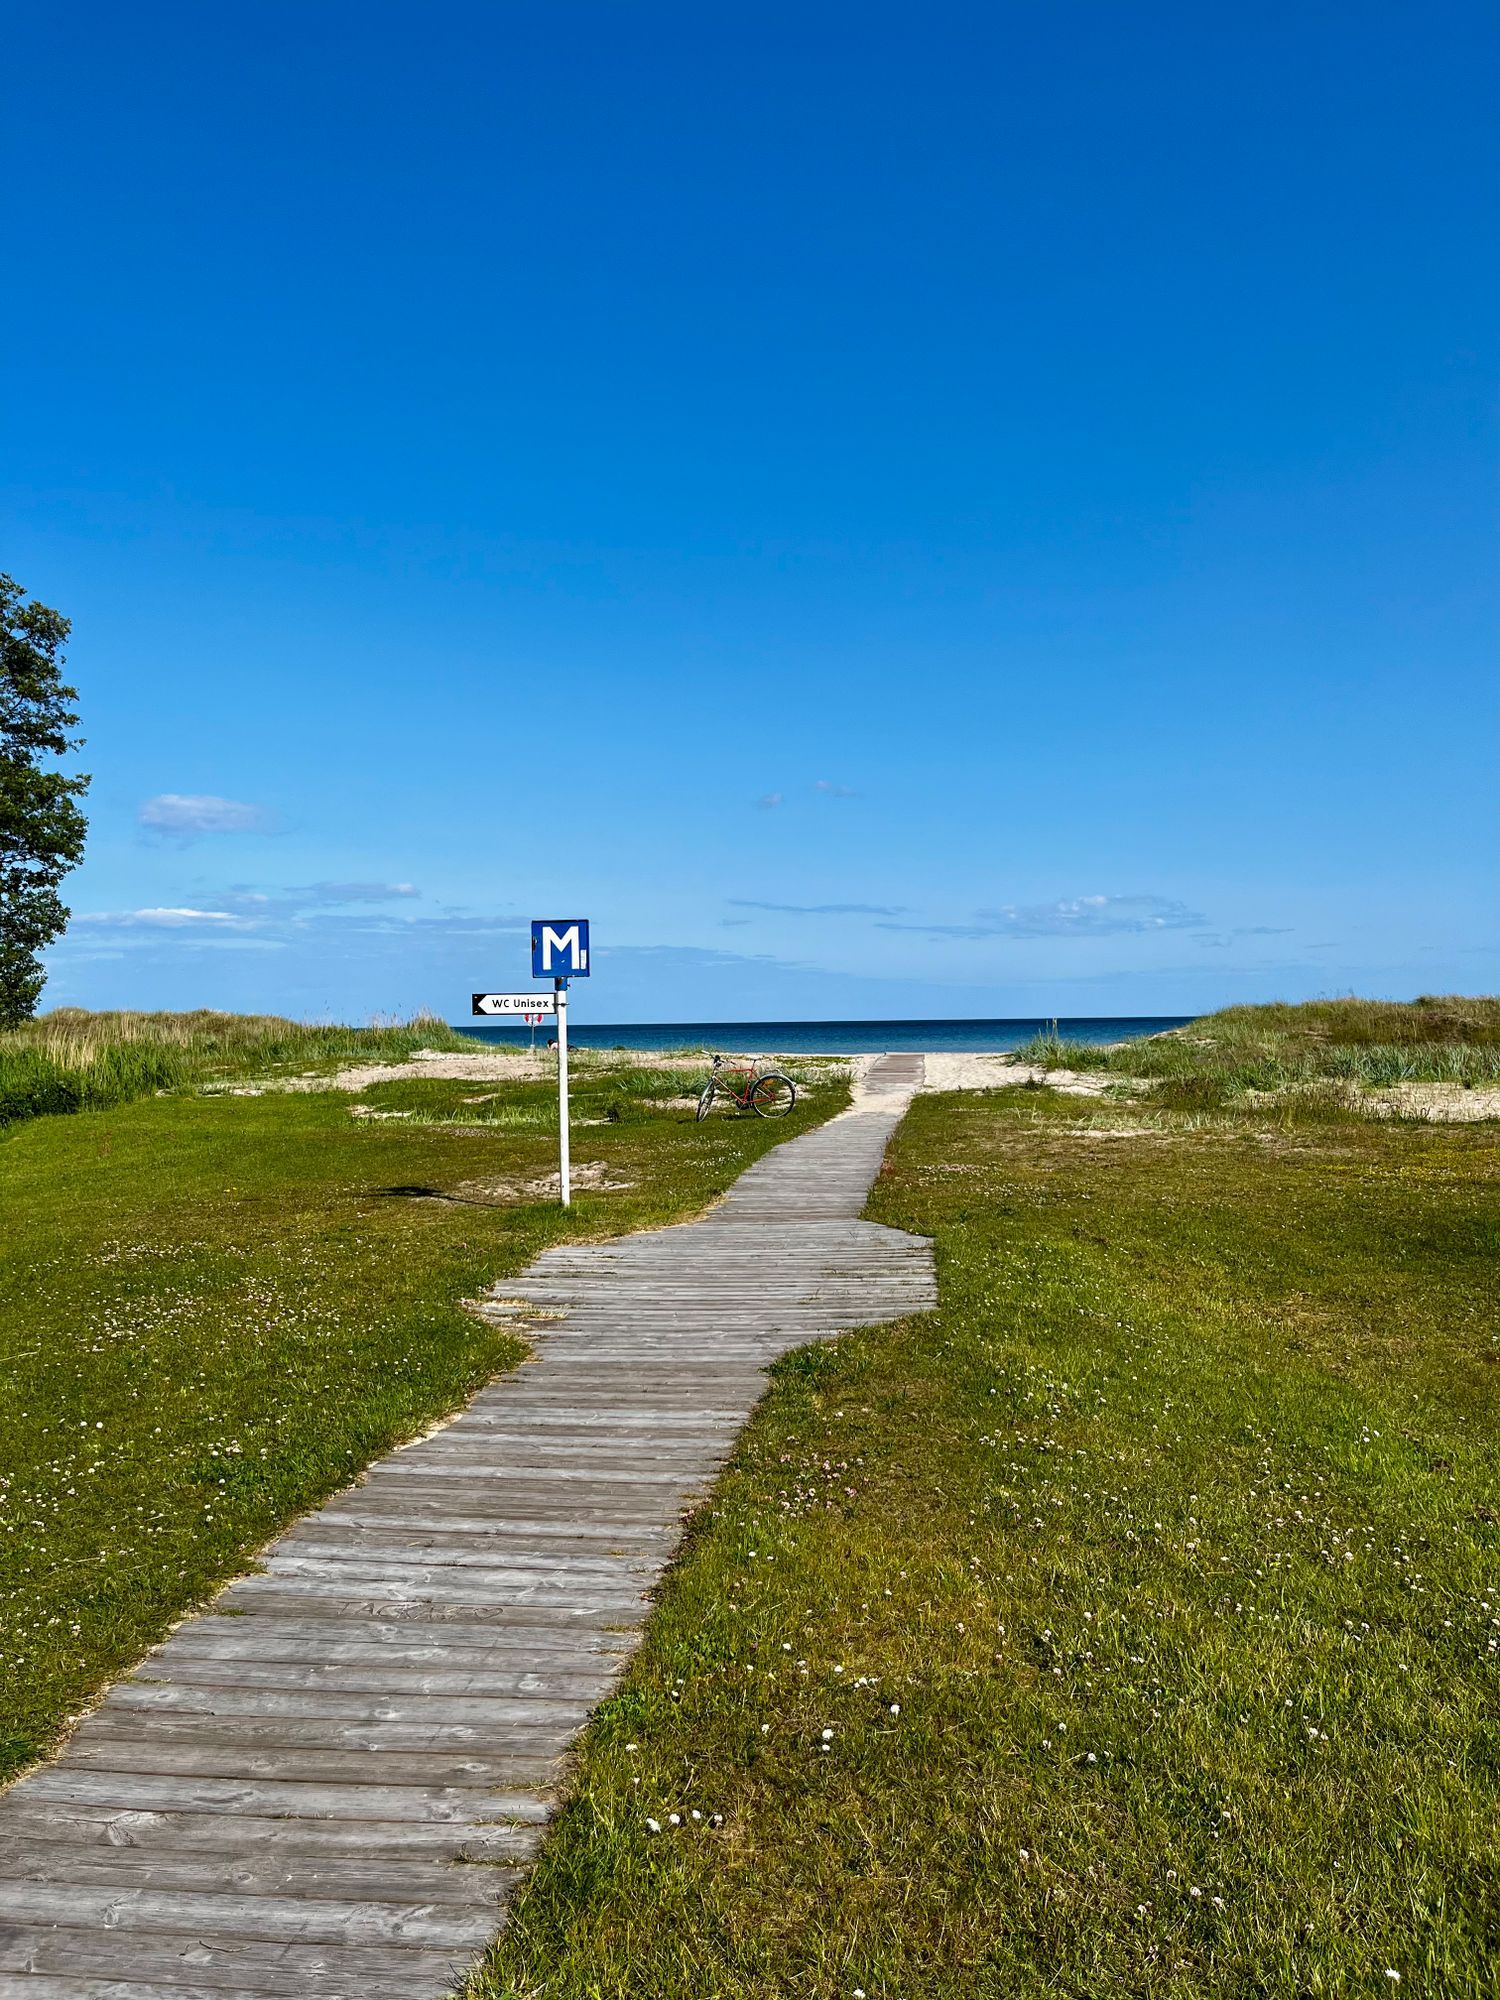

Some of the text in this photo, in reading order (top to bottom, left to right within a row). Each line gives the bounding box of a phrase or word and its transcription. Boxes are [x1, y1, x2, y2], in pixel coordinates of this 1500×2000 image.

[542, 926, 580, 970] M
[492, 998, 549, 1008] WC Unisex
